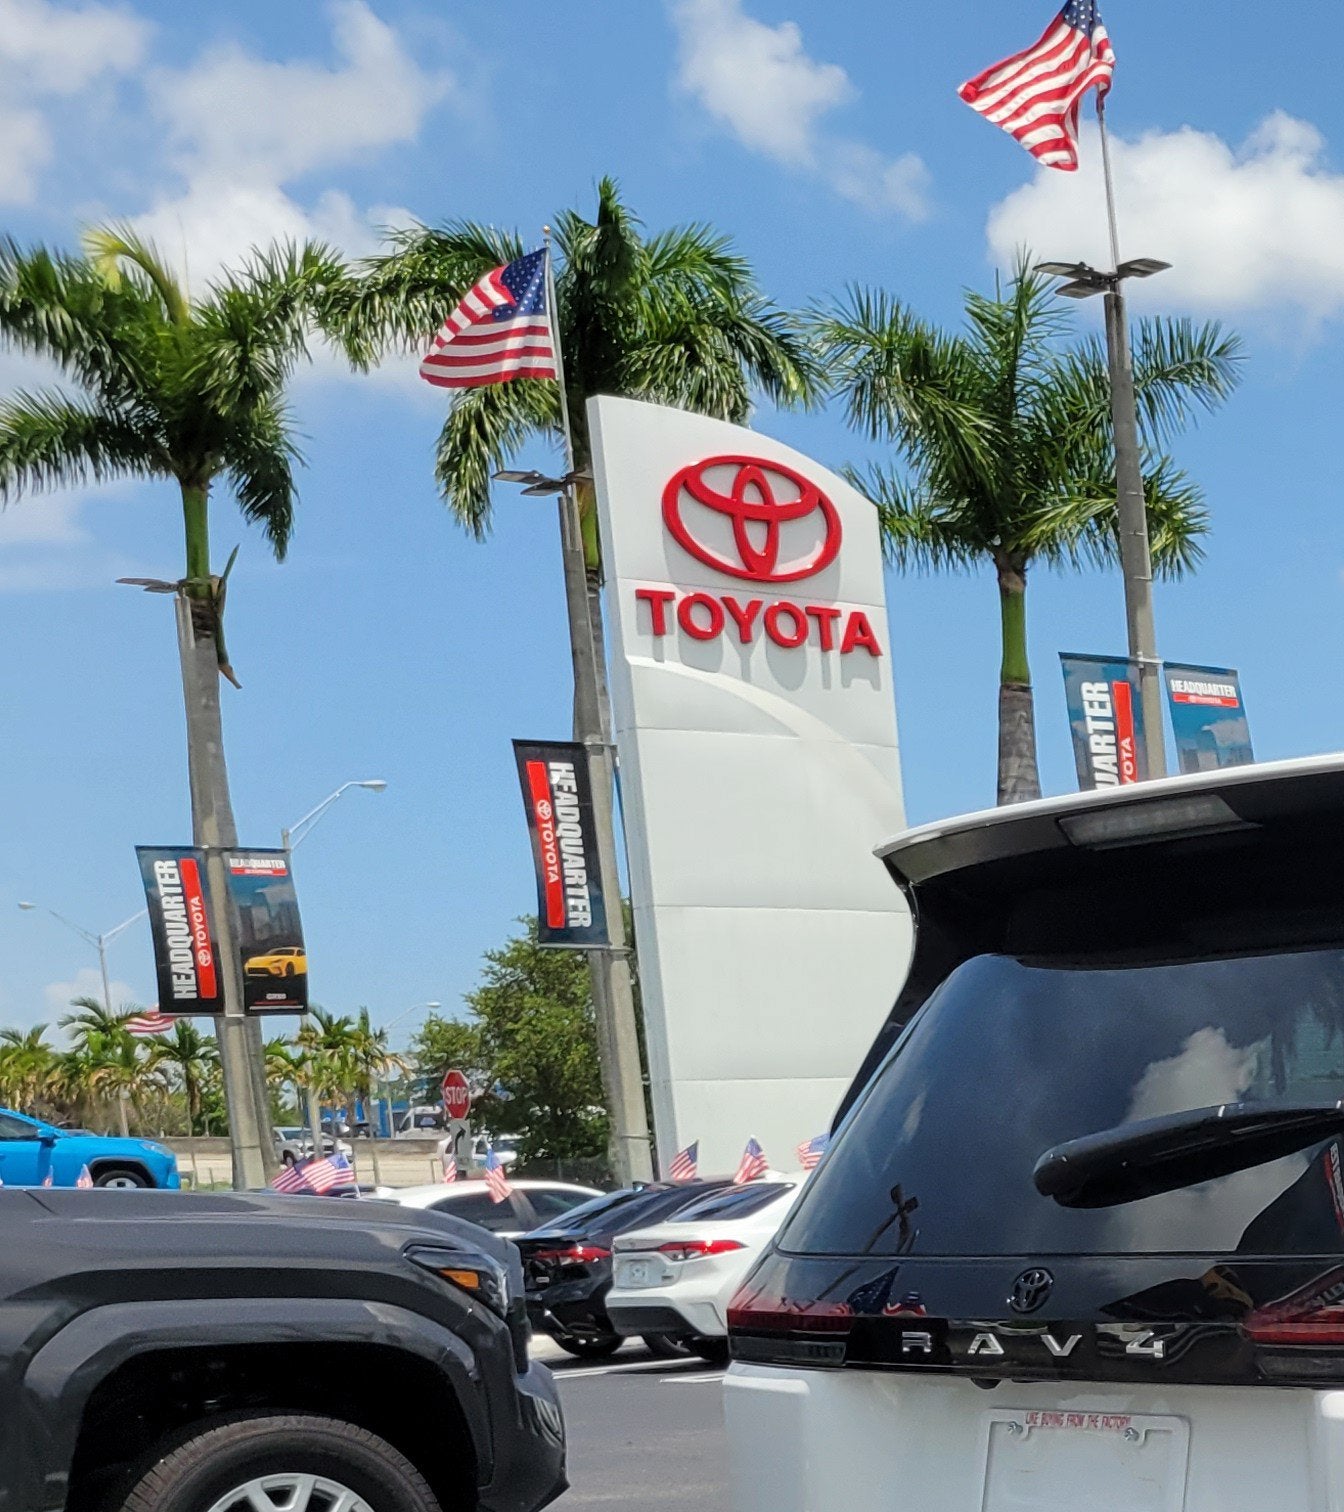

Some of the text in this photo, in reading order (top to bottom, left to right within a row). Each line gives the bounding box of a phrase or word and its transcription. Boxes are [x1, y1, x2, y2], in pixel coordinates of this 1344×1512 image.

[635, 588, 883, 656] TOYOTA
[1170, 679, 1237, 697] HEADQUARTER
[542, 822, 559, 883] TOYOTA
[548, 762, 593, 928] HEADQUARTER
[153, 860, 197, 999] HEADQUARTER
[190, 896, 208, 947] TOYOTA
[445, 1086, 468, 1105] STOP
[902, 1331, 1164, 1357] RAV4
[1088, 1415, 1099, 1428] THE
